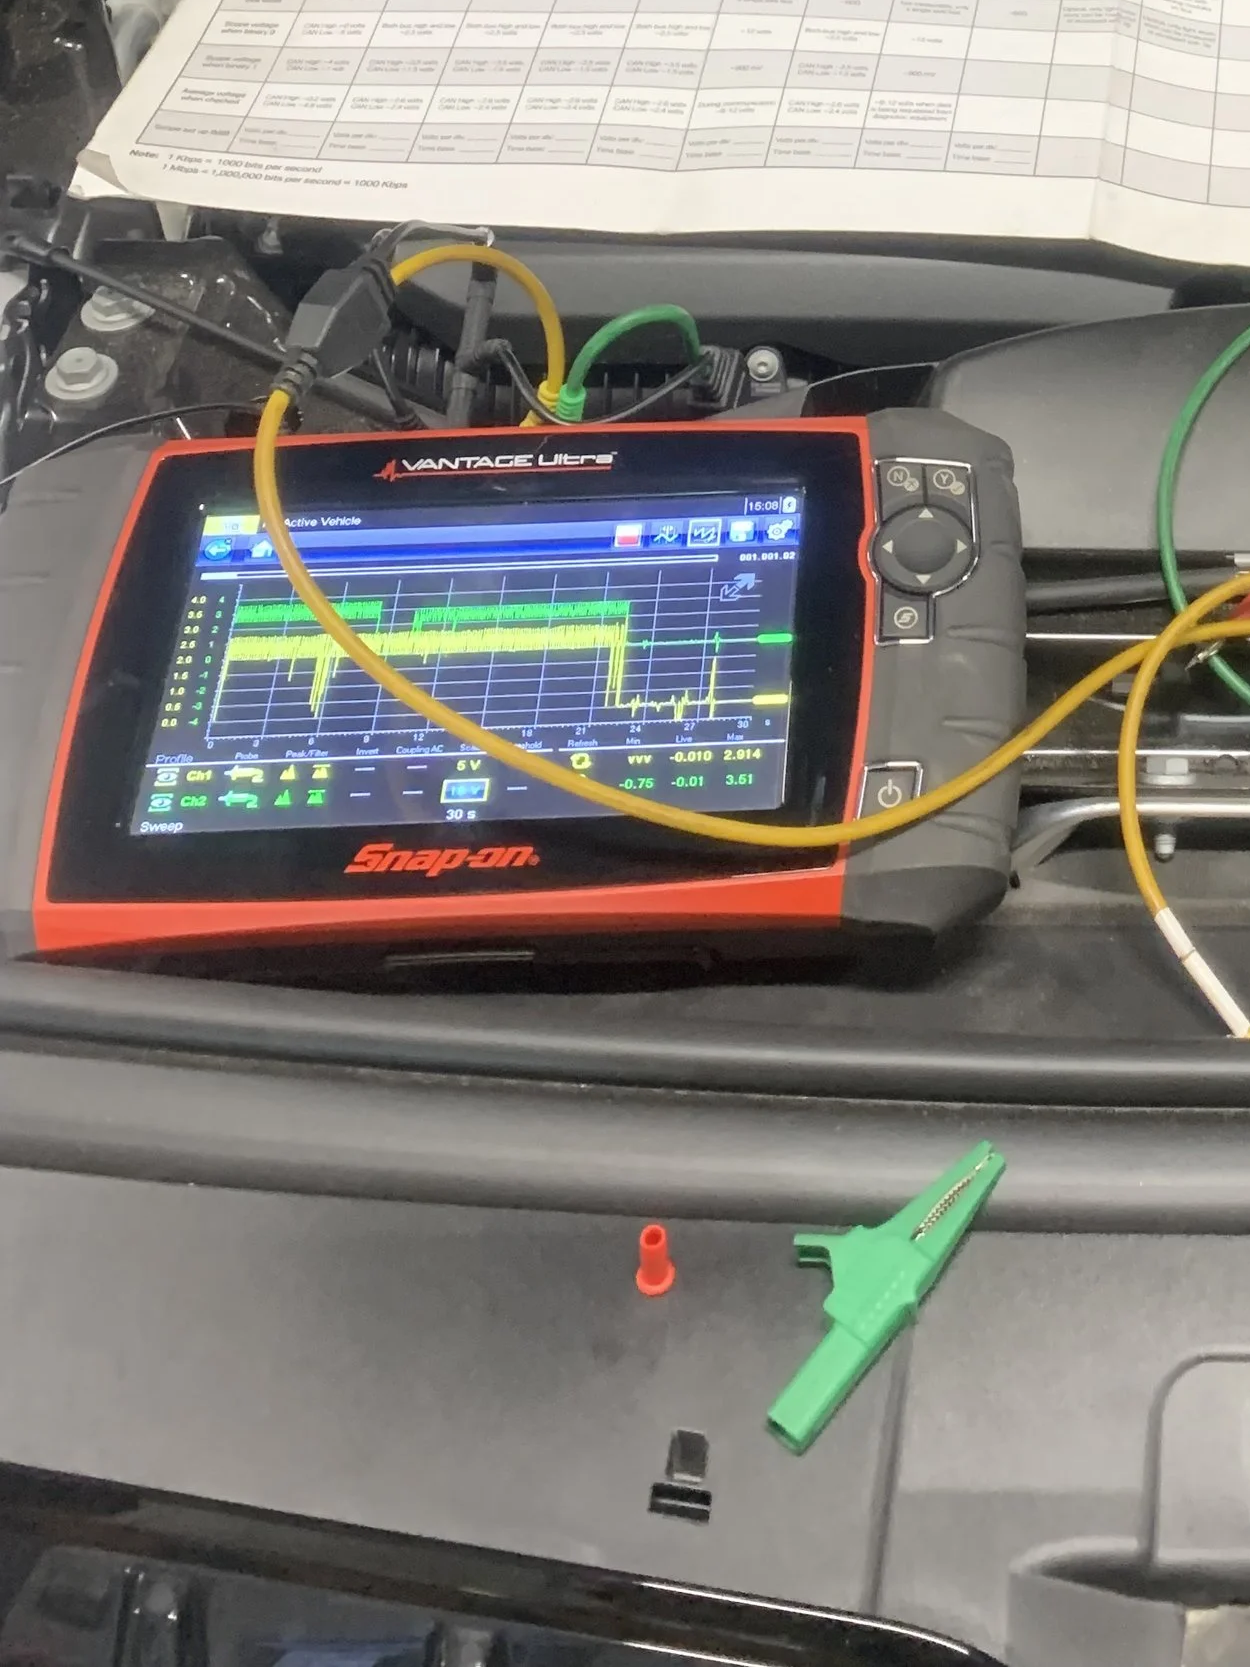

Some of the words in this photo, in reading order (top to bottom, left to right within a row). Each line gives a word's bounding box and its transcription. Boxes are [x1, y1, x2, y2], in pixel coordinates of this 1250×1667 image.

[128, 149, 159, 159] Note:
[176, 154, 203, 164] Kbps
[216, 158, 243, 169] 1000
[244, 161, 263, 170] bits
[264, 164, 282, 173] per
[283, 164, 323, 174] second
[169, 165, 199, 175] Mbps
[263, 173, 283, 182] bits
[284, 175, 302, 184] per
[303, 176, 342, 186] second
[354, 180, 380, 189] 1000
[380, 181, 408, 190] Kbps
[401, 453, 535, 471] VANTAGE
[538, 451, 614, 467] Ultra
[748, 501, 779, 511] 15:08
[284, 517, 318, 528] Active
[321, 516, 362, 526] Vehicle
[739, 551, 796, 562] 001.001.02
[191, 595, 207, 604] 4.0
[219, 596, 225, 604] 4
[187, 610, 203, 619] 3.5
[215, 610, 222, 619] 3
[183, 625, 200, 634] 3.0
[211, 625, 219, 634] 2
[180, 640, 196, 649] 2.5
[208, 640, 214, 649] 1
[176, 655, 193, 665] 2.0
[204, 655, 212, 664] 0
[173, 671, 189, 680] 1.5
[199, 671, 209, 679] -1
[169, 686, 185, 696] 1.0
[195, 686, 206, 695] -2
[165, 702, 182, 712] 0.5
[161, 718, 178, 728] 0.0
[207, 741, 215, 749] 0
[308, 738, 315, 746] 6
[363, 735, 370, 743] 9
[413, 733, 425, 742] 12
[522, 729, 533, 738] 18
[575, 726, 586, 735] 21
[630, 725, 642, 734] 24
[684, 722, 695, 731] 27
[737, 720, 749, 729] 30
[155, 753, 194, 764] Profile
[234, 752, 260, 760] Probe
[285, 750, 329, 759] Peak/Filter
[356, 747, 379, 756] Invert
[396, 745, 431, 755] Coupling
[431, 744, 443, 753] AC
[567, 739, 598, 748] Refresh
[626, 737, 641, 745] Min
[676, 735, 693, 744] Live
[726, 733, 744, 742] Max
[186, 769, 213, 782] Ch1
[456, 760, 468, 771] 5
[470, 759, 481, 771] V
[669, 750, 712, 763] -0.010
[723, 748, 762, 761] 2.914
[180, 795, 208, 807] Ch2
[619, 777, 655, 790] -0.75
[671, 775, 704, 788] -0.01
[725, 773, 753, 786] 3.51
[446, 809, 463, 821] 30
[467, 810, 477, 819] s
[140, 821, 184, 834] Sweep
[344, 842, 534, 877] Snap-on
